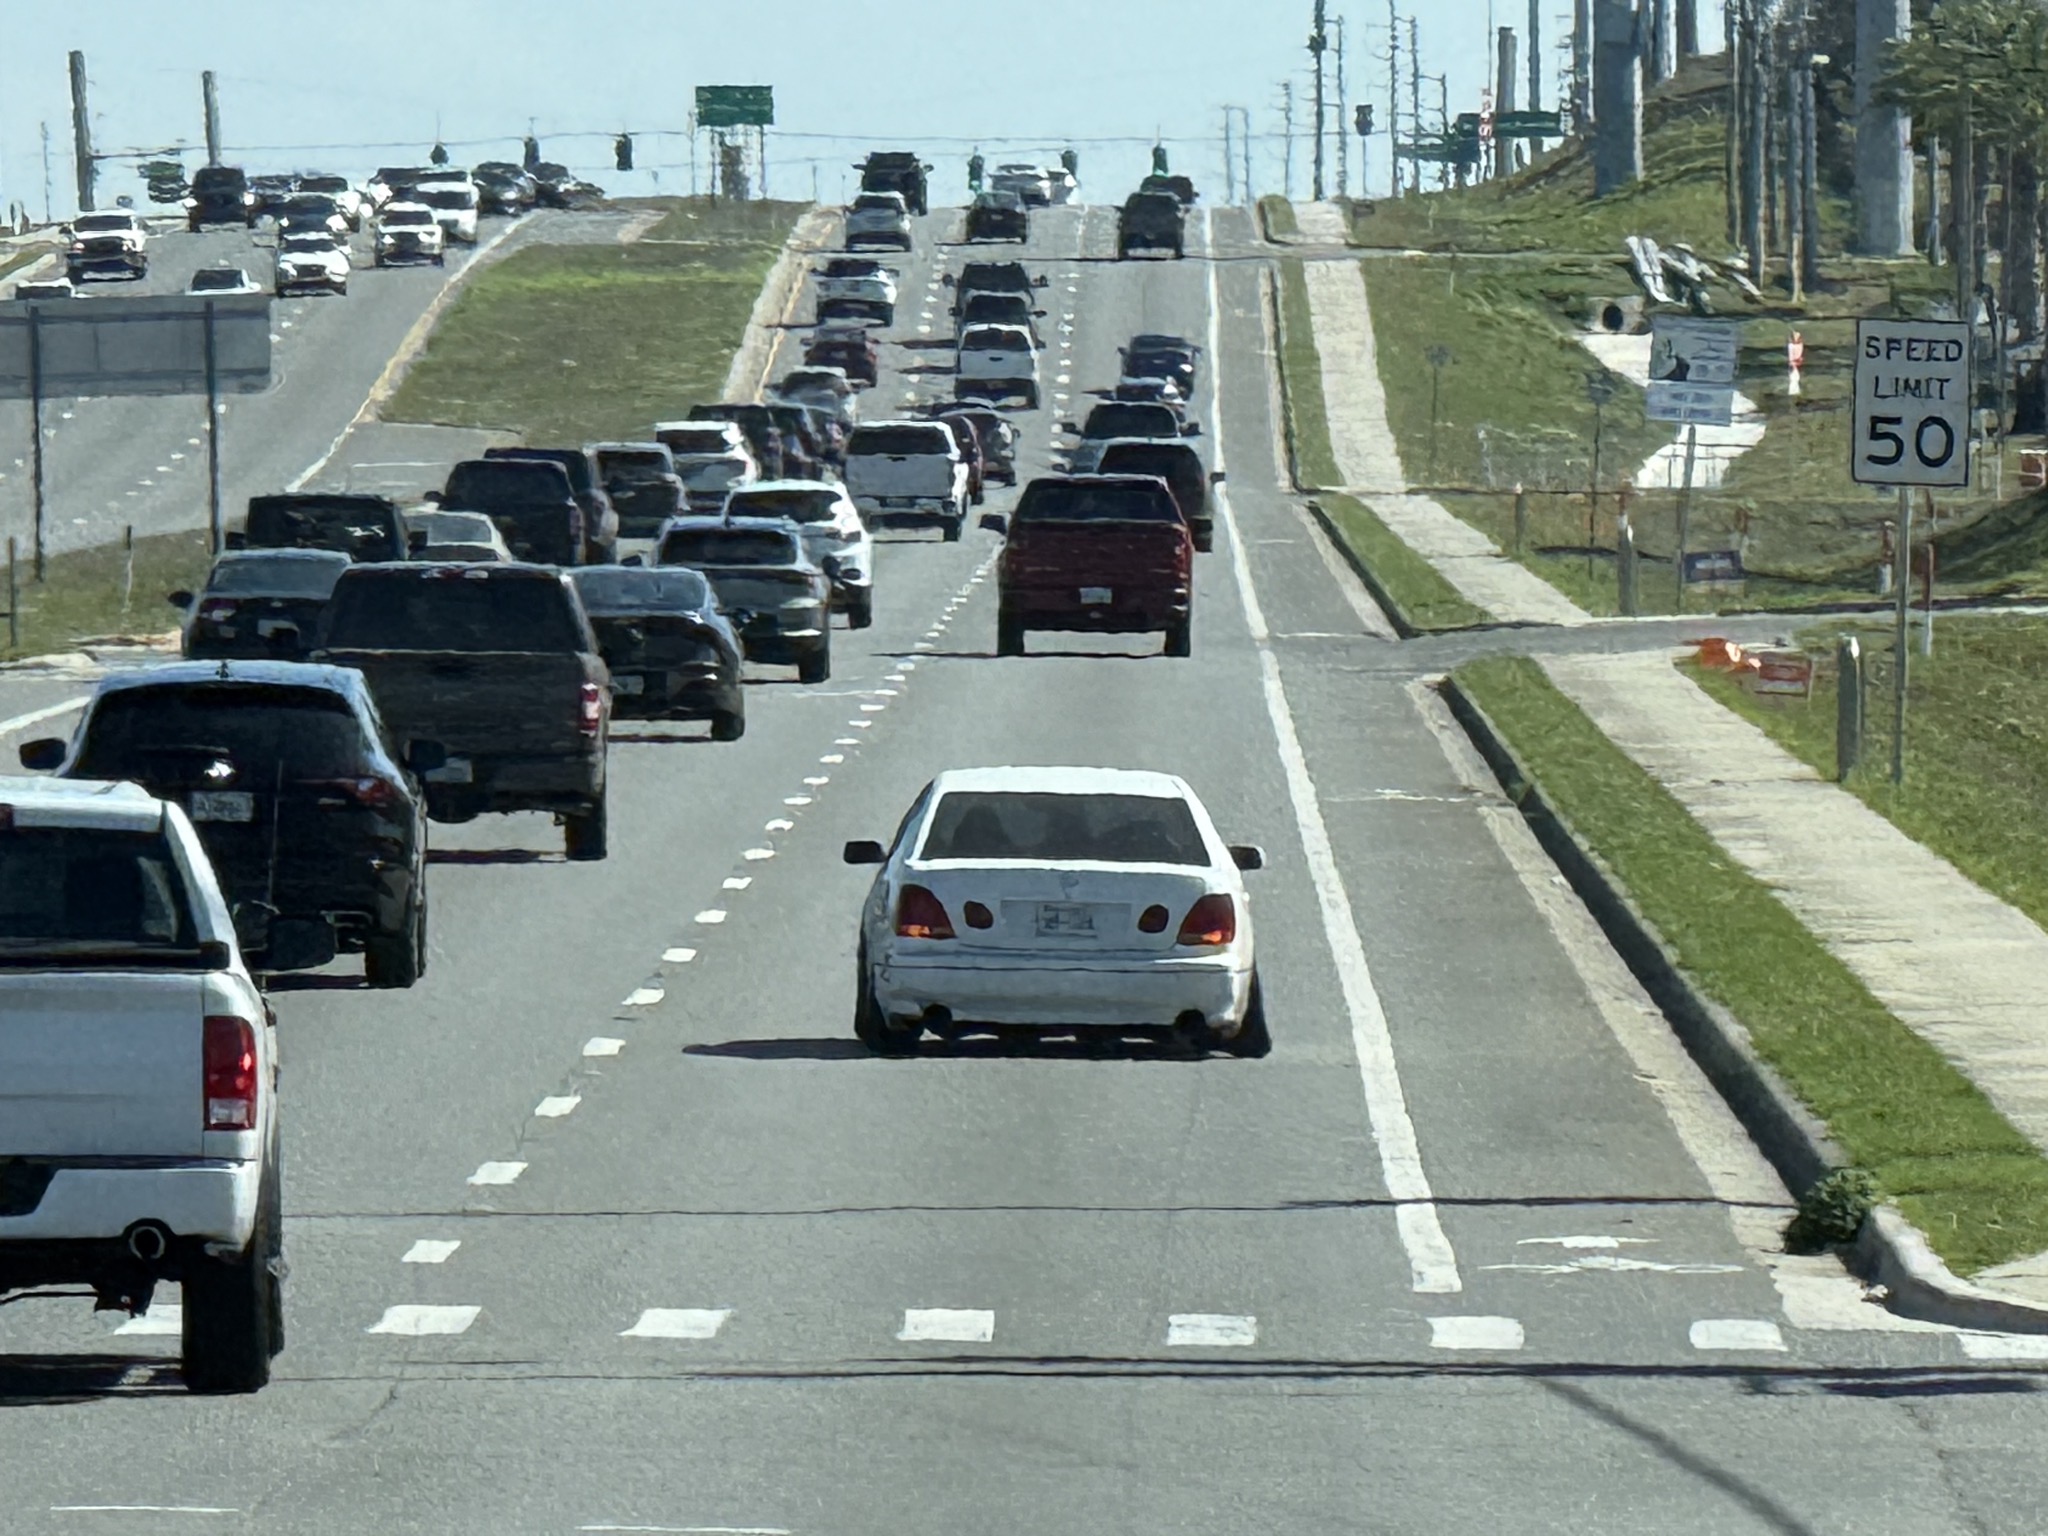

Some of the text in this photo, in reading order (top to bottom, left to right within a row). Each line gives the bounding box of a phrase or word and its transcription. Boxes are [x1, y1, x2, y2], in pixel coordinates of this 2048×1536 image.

[1865, 335, 1963, 362] SPEED
[1874, 375, 1952, 400] LIMIT
[1866, 415, 1955, 468] 50
